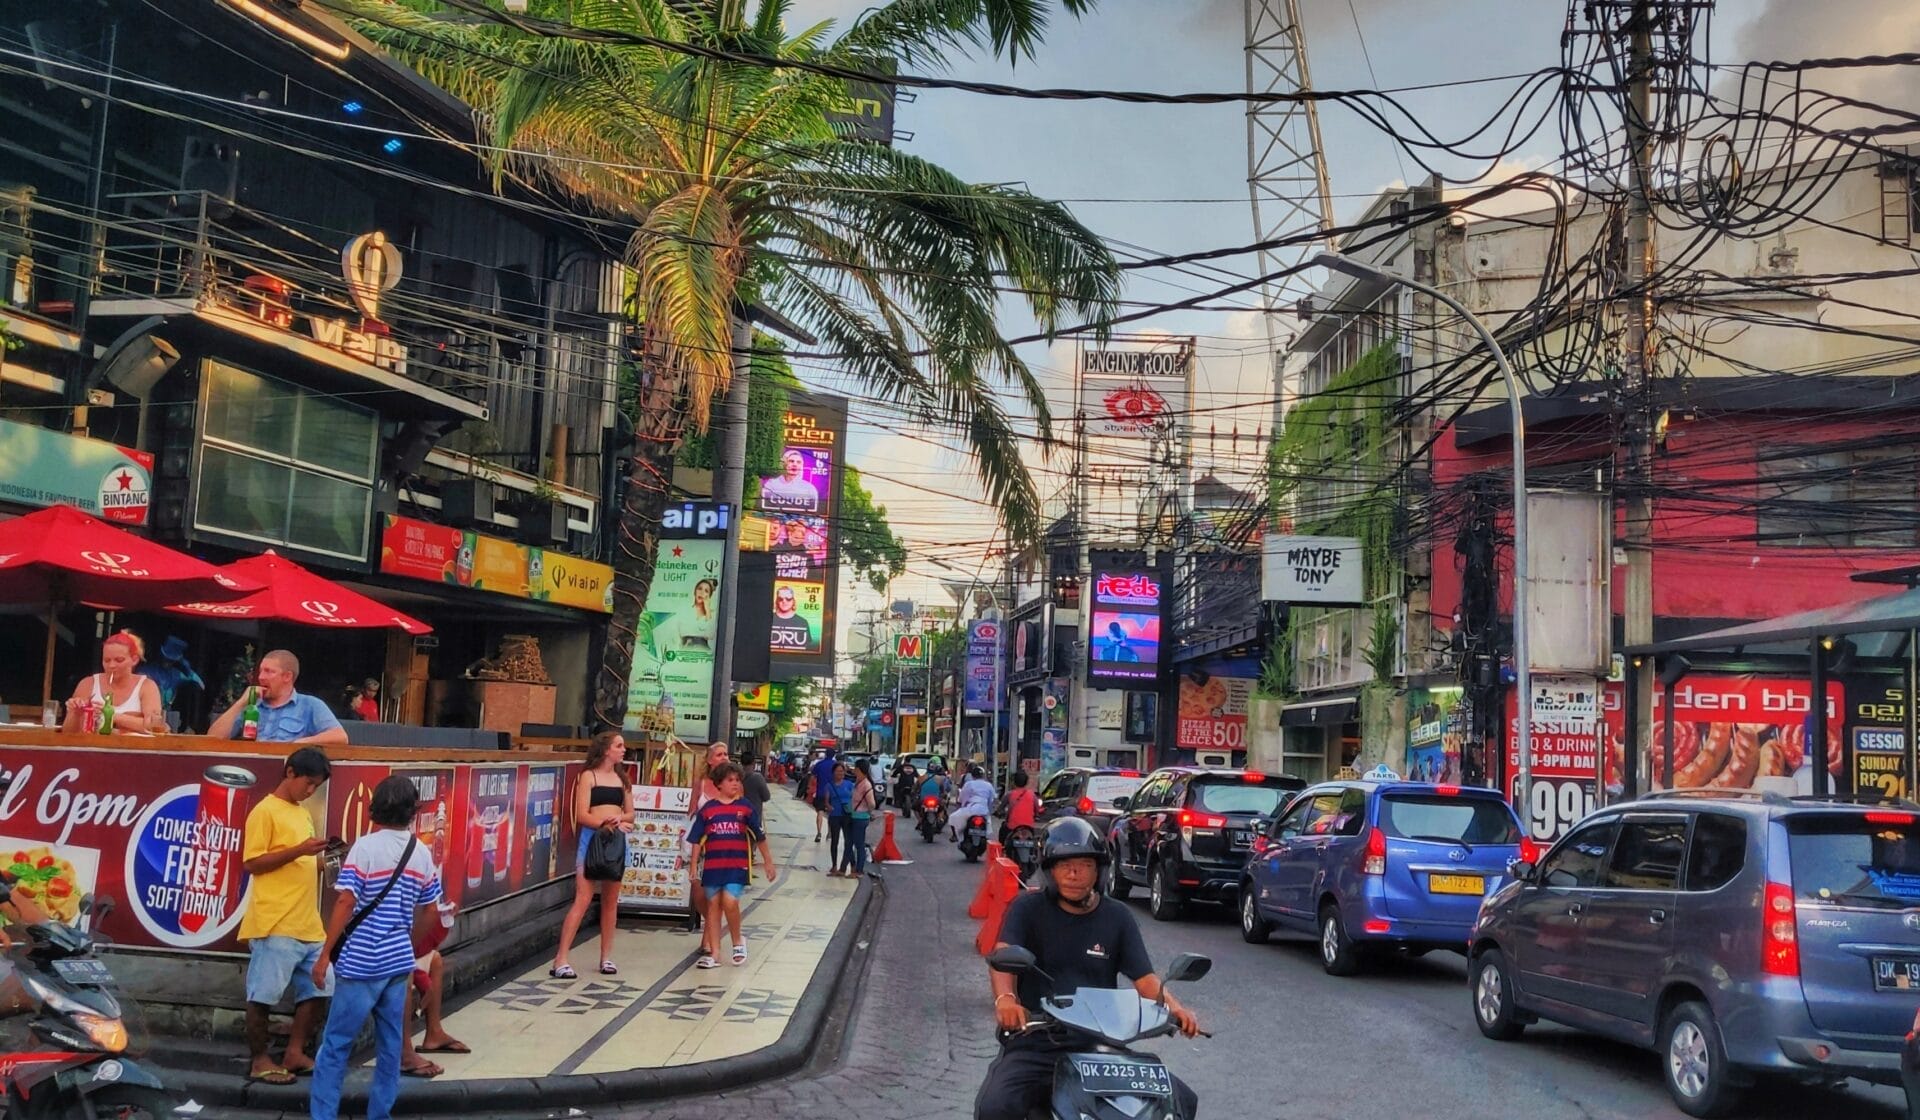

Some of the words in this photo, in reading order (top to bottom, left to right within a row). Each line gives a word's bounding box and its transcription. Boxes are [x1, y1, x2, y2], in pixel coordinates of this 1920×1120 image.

[1087, 352, 1139, 374] ENGINE
[816, 460, 824, 468] 6
[103, 493, 147, 506] BINTANG
[662, 504, 693, 528] ai
[698, 505, 729, 534] pi
[1288, 547, 1342, 568] MAYBE
[568, 574, 578, 587] vi
[579, 577, 588, 590] ai
[589, 577, 599, 592] pi
[663, 572, 687, 582] LIGHT
[1294, 568, 1335, 585] TONY
[1097, 576, 1160, 598] reds
[809, 595, 816, 603] 8
[804, 603, 820, 611] DEC
[1182, 719, 1211, 728] PIZZA
[1180, 736, 1212, 745] SLICE
[1511, 736, 1539, 751] BQ
[1543, 737, 1553, 751] &
[1511, 753, 1570, 768] 5M-9PM
[1860, 757, 1899, 770] SUNDAY
[1372, 772, 1396, 780] TAKSI
[36, 767, 147, 847] 6pm
[154, 817, 200, 845] COMES
[206, 826, 241, 852] WITH
[163, 845, 221, 891] FREE
[630, 853, 647, 868] 5K
[146, 885, 180, 912] SOFT
[184, 891, 228, 919] DRINK
[1880, 962, 1896, 978] DK
[1083, 1064, 1100, 1077] DK
[1103, 1063, 1135, 1077] 2325
[1140, 1066, 1167, 1080] FAA
